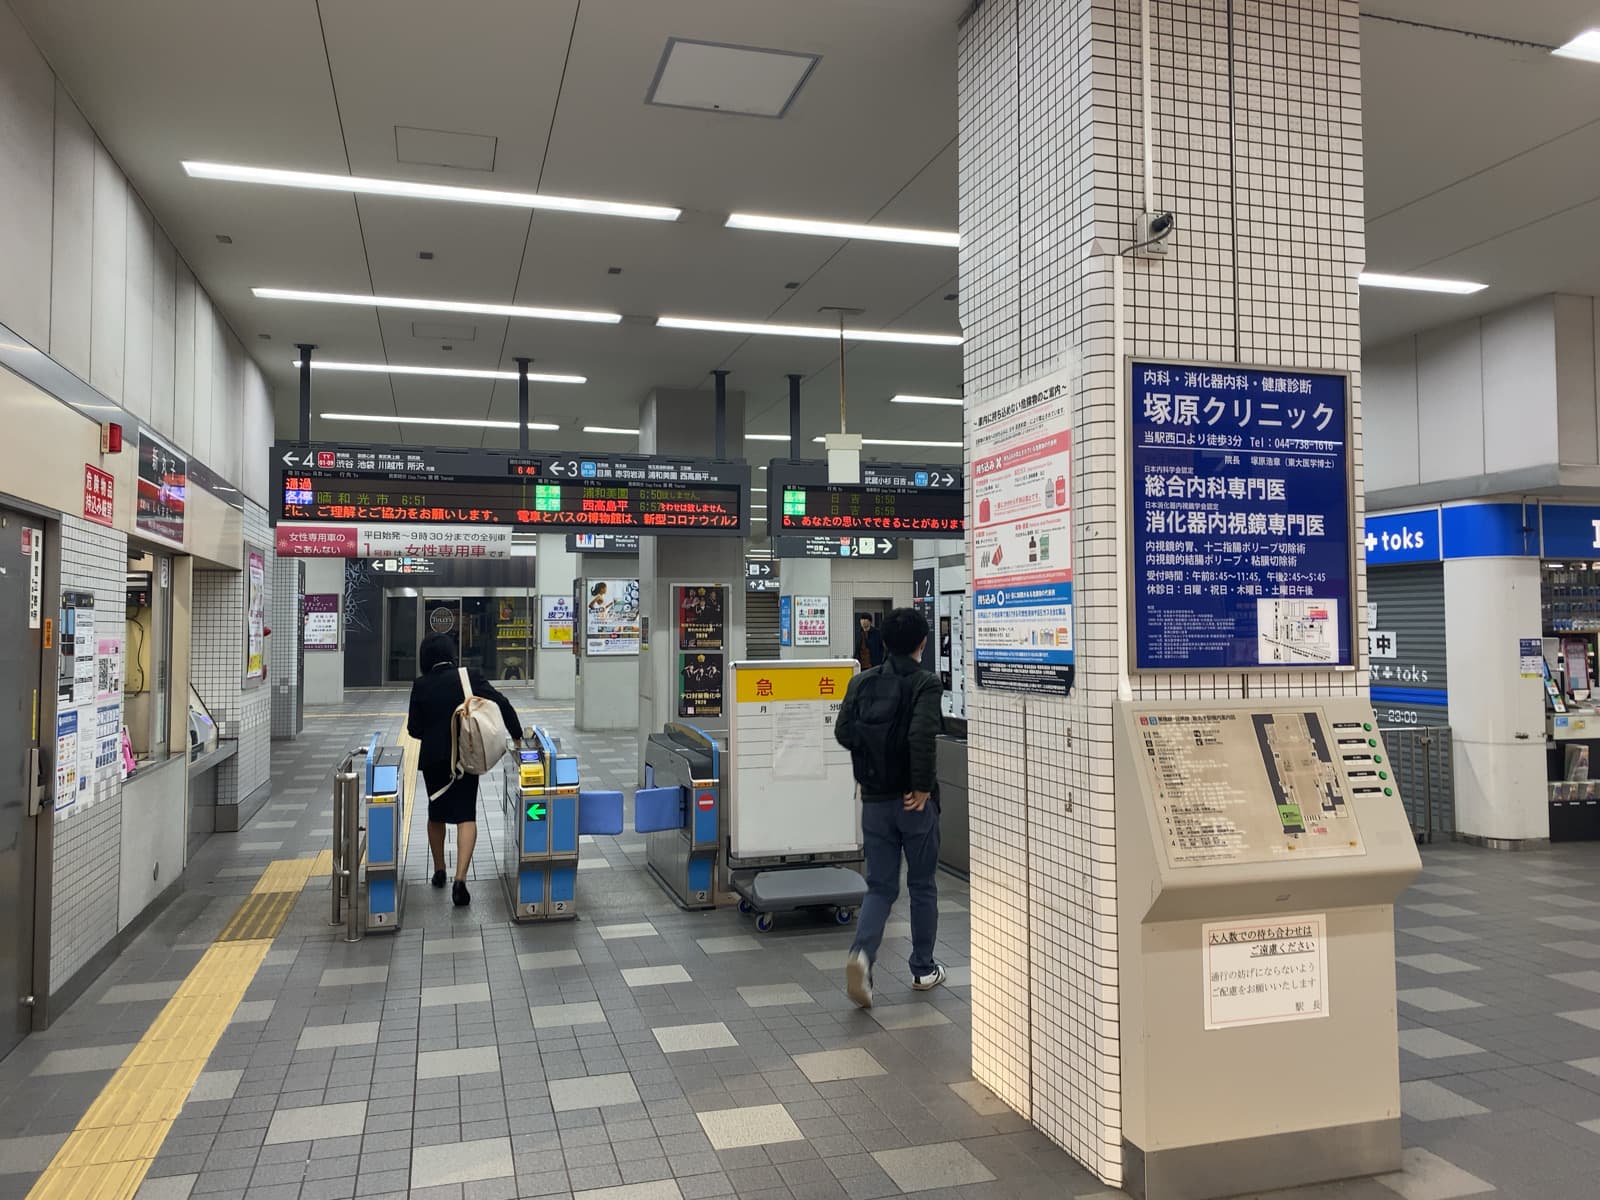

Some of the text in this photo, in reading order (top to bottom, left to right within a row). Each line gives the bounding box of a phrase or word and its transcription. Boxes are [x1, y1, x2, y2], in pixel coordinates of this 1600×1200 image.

[1144, 370, 1312, 394] 内科・消化器内科・健康診断
[1144, 392, 1334, 432] 塚原クリニック
[1144, 430, 1242, 446] 当駅西口より徒歩3分
[302, 452, 314, 468] 4
[336, 460, 354, 469] 渋谷
[357, 461, 374, 470] 池袋
[378, 461, 404, 470] 川越市
[407, 462, 424, 471] 所沢
[568, 461, 578, 477] 3
[680, 472, 709, 480] 西高島平
[286, 478, 312, 490] 通過
[930, 472, 939, 487] 2
[1144, 475, 1286, 500] 総合内科専門医
[1146, 510, 1325, 536] 消化器内視鏡専門医
[289, 533, 345, 543] 女性専用車の
[364, 531, 506, 542] 平日始発～9時30分までの全列車
[1382, 526, 1424, 550] toks
[852, 546, 858, 556] 2
[915, 580, 931, 597] 1 2
[1397, 665, 1428, 682] toks
[756, 677, 835, 696] 急 告
[1252, 941, 1314, 956] ご遠慮ください
[1212, 978, 1316, 998] ご配慮をお願いいたします
